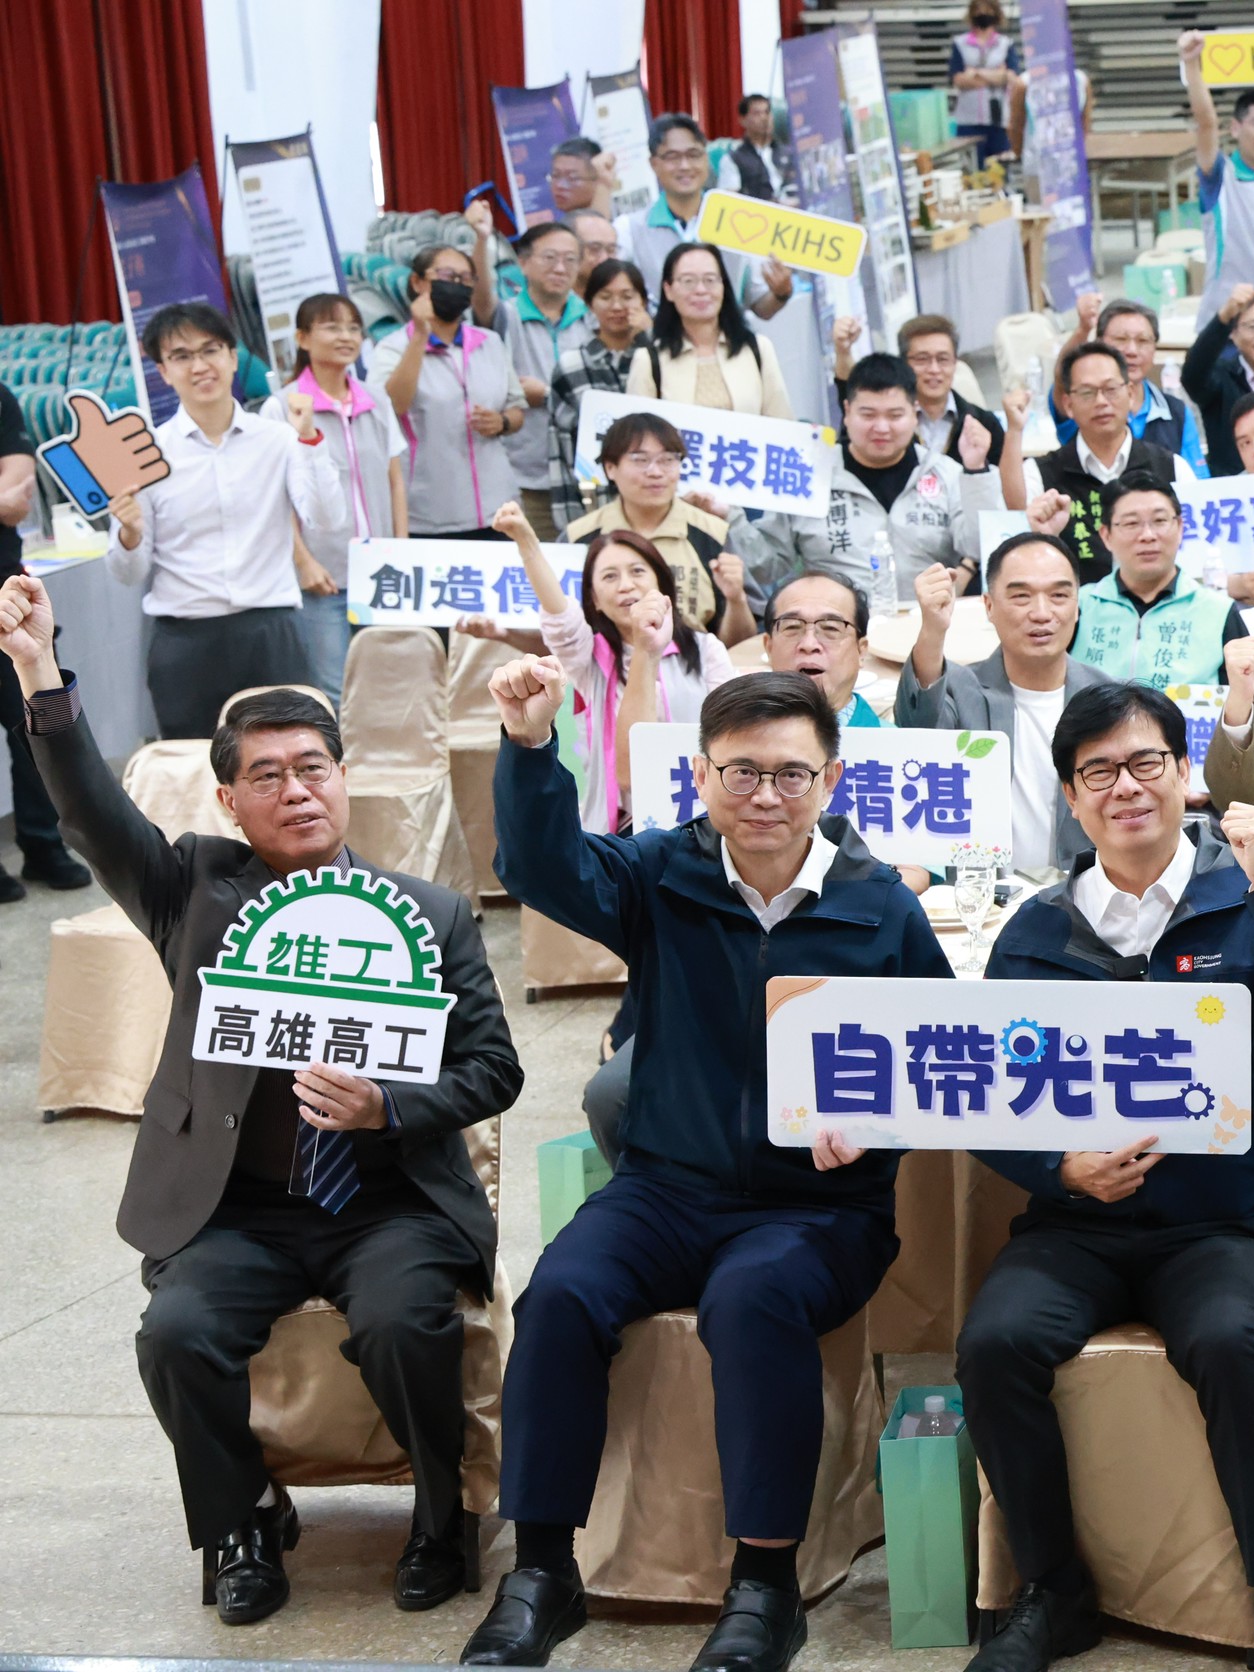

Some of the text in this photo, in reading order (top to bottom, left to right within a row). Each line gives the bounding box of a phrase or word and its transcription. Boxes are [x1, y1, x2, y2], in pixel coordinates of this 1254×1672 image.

[715, 207, 844, 262] I KIHS
[267, 931, 393, 987] 雄工
[207, 1004, 429, 1074] 高雄高工
[810, 1017, 1216, 1121] 自帶光芒
